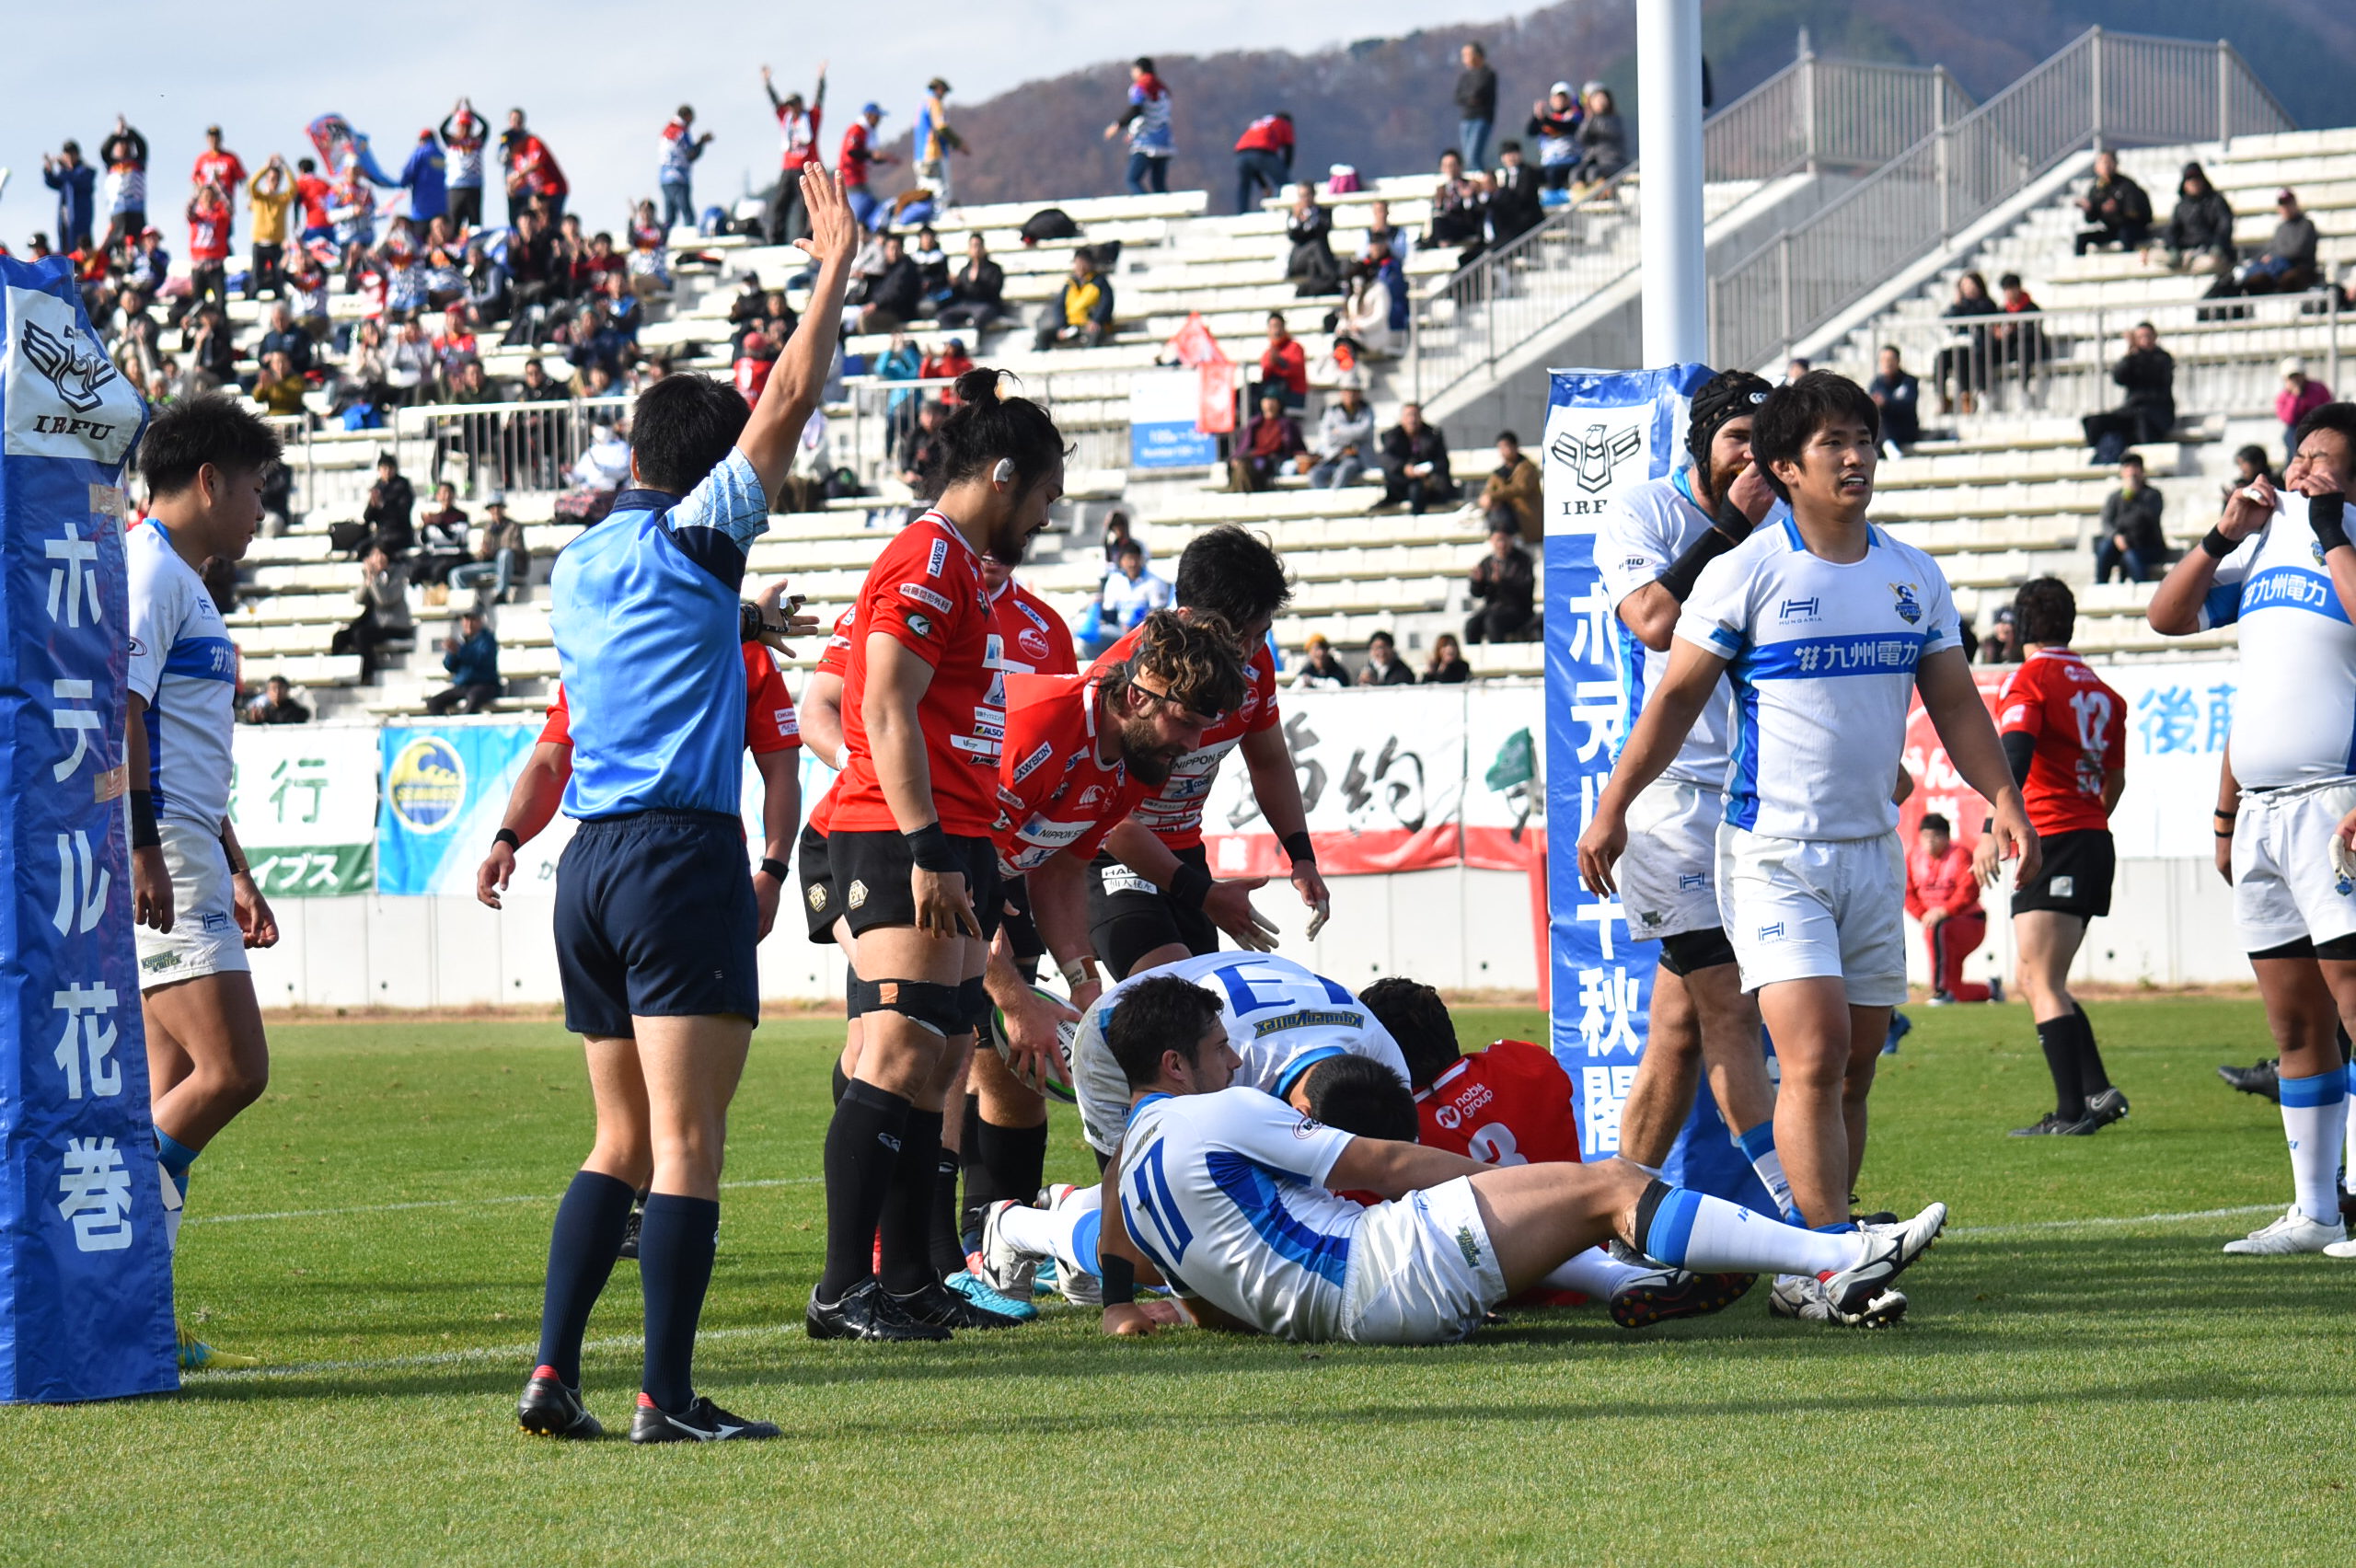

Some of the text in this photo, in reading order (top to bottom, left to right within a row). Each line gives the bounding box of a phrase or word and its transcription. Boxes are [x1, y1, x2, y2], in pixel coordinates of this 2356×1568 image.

[33, 414, 116, 441] IRFU
[2254, 571, 2327, 607] 九州電力
[1779, 617, 1823, 626] HUNGARIA
[1823, 640, 1920, 670] 九州電力
[2069, 689, 2111, 752] 12
[1172, 753, 1215, 769] NIPPON
[1040, 829, 1070, 838] NIPPON
[45, 522, 133, 1252] ホテル花巻
[1455, 1082, 1485, 1107] noble
[1462, 1089, 1494, 1118] group
